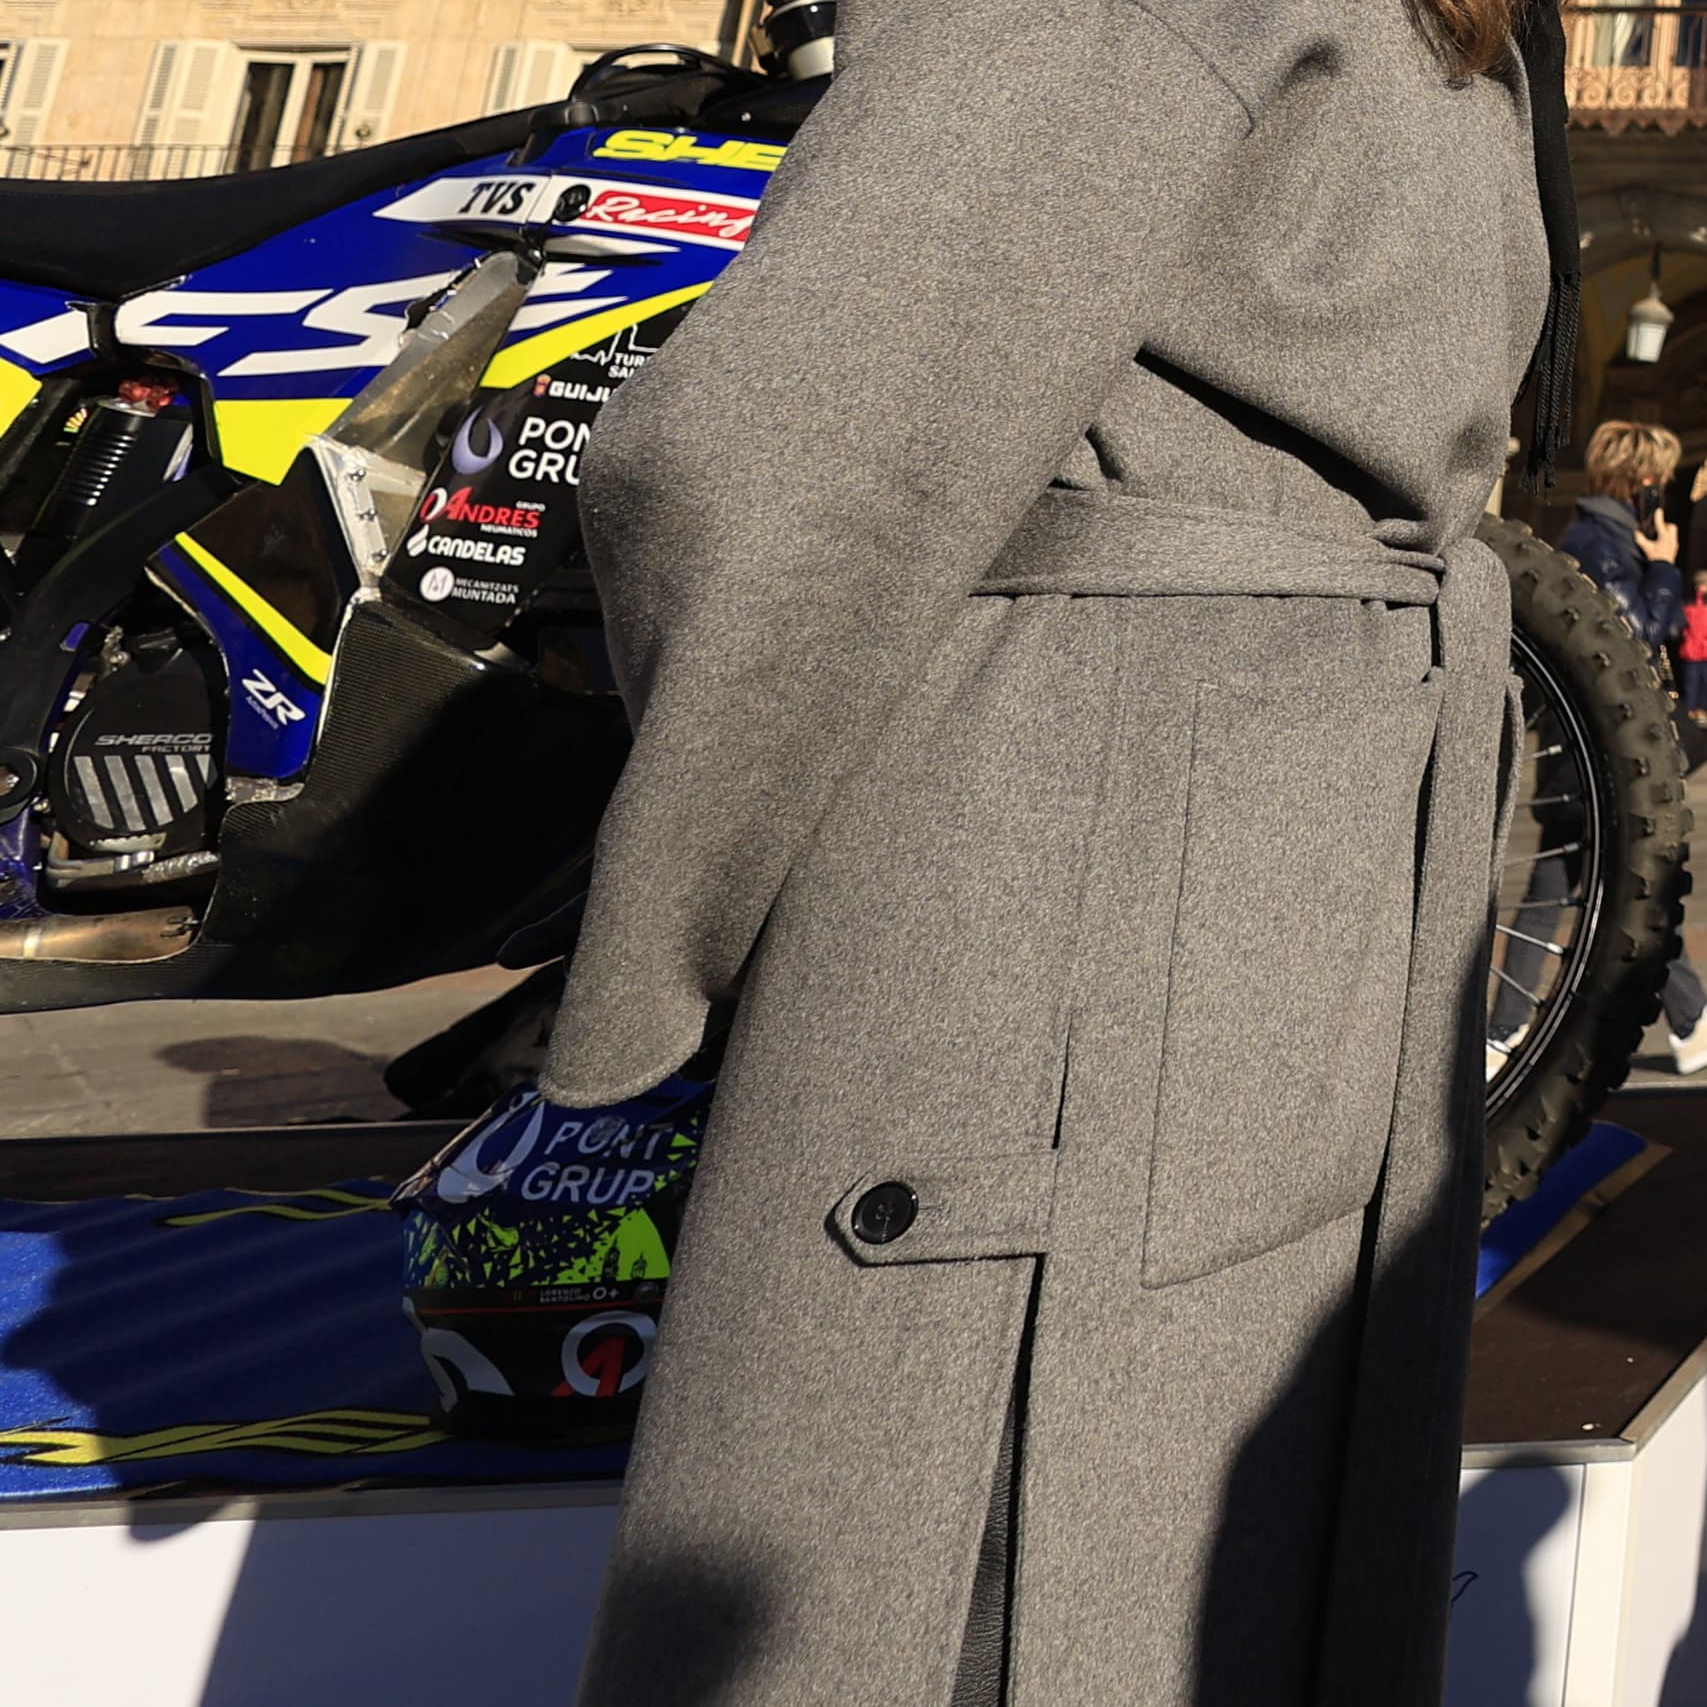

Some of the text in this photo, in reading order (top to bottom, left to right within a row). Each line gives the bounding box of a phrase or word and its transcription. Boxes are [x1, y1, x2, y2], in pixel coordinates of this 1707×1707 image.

[459, 181, 534, 216] TVS
[586, 195, 757, 238] Racing
[428, 535, 526, 566] CANDELAS
[242, 668, 306, 726] ZR
[95, 733, 213, 746] SHERCO
[544, 1120, 673, 1161] PONT
[521, 1161, 656, 1205] GRUP
